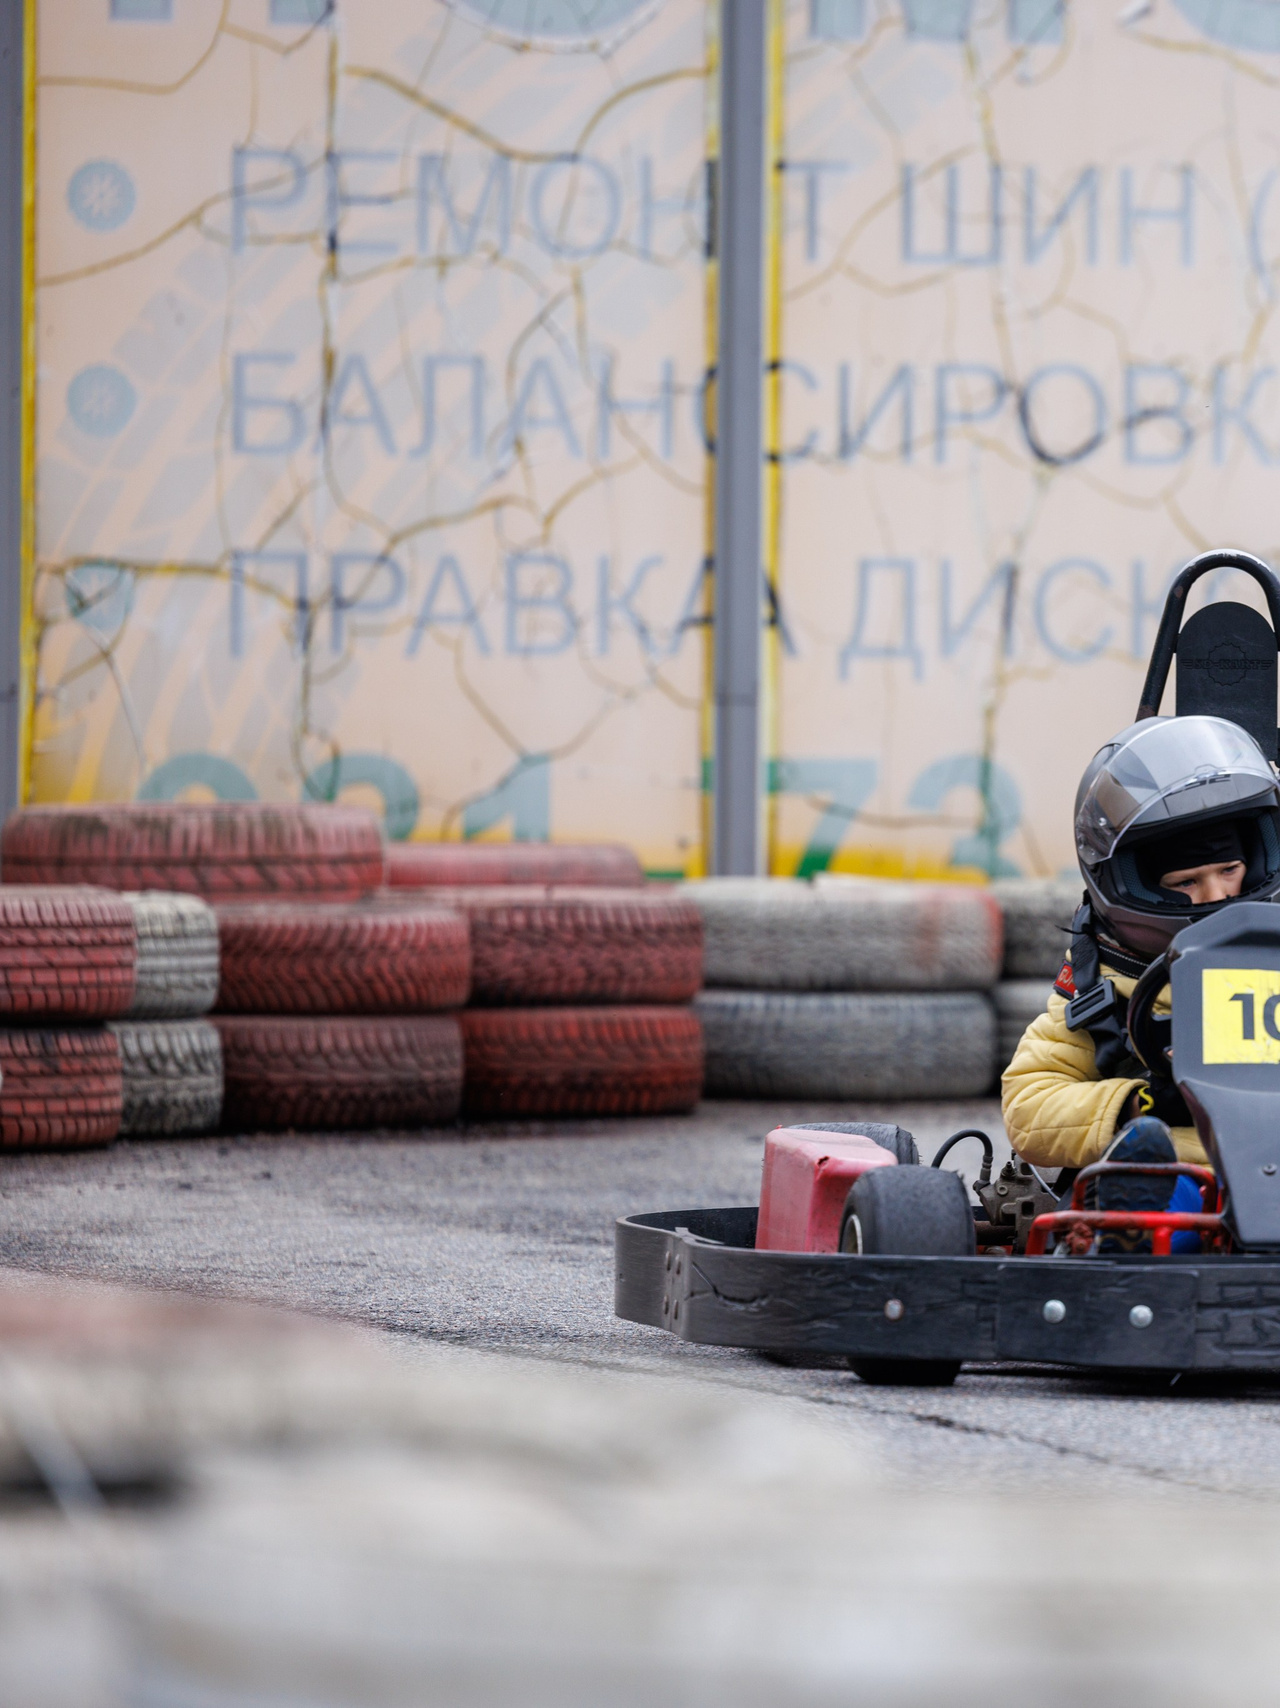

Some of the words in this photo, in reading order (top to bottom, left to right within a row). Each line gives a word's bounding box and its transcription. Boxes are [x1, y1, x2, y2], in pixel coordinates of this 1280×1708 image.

[229, 143, 852, 266] РЕМОНТ
[901, 160, 1199, 269] ШИН
[228, 548, 797, 659] ПРАВКА
